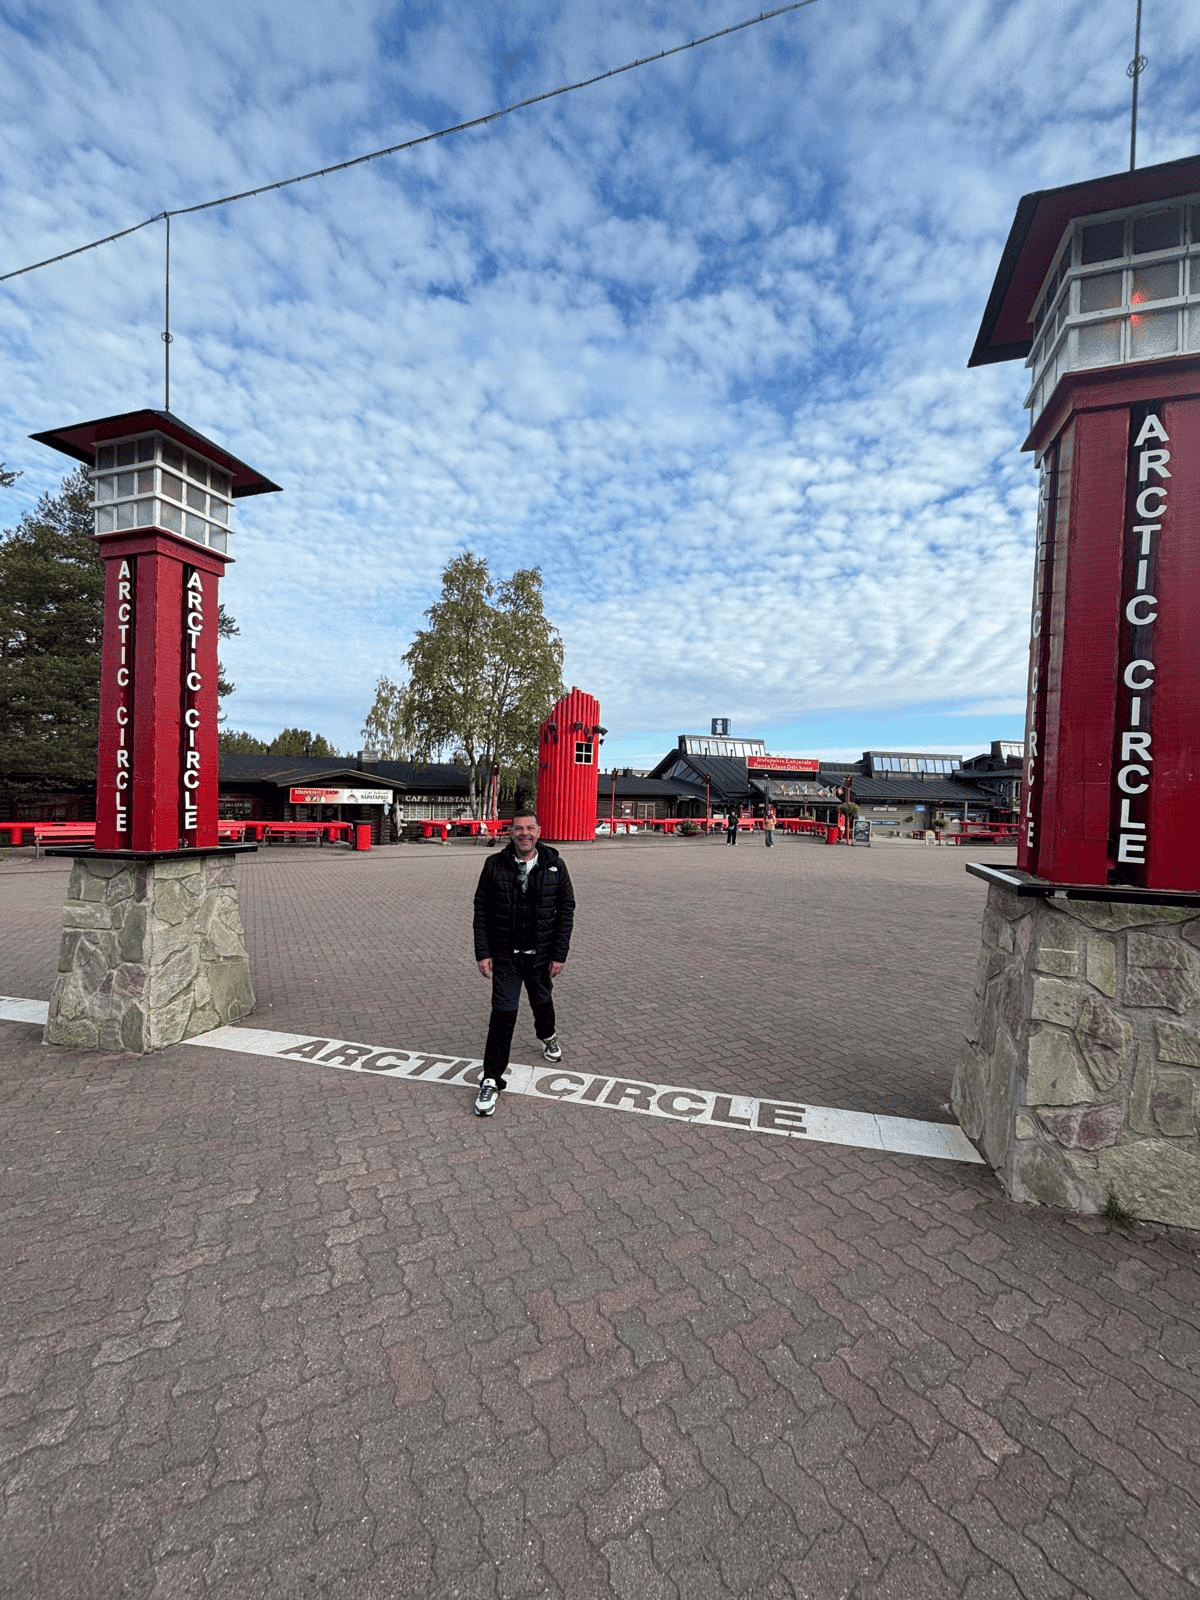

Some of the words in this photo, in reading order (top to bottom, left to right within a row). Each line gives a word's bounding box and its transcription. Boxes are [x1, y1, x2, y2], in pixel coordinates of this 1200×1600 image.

[1033, 456, 1047, 638] ARCTIC
[1126, 414, 1172, 626] ARCTIC
[117, 560, 131, 686] ARCTIC
[187, 571, 203, 691] ARCTIC
[116, 706, 130, 832] CIRCLE
[184, 708, 200, 830] CIRCLE
[1026, 666, 1038, 847] CIRCLE
[1117, 659, 1156, 864] CIRCLE
[535, 1073, 807, 1134] CIRCLE
